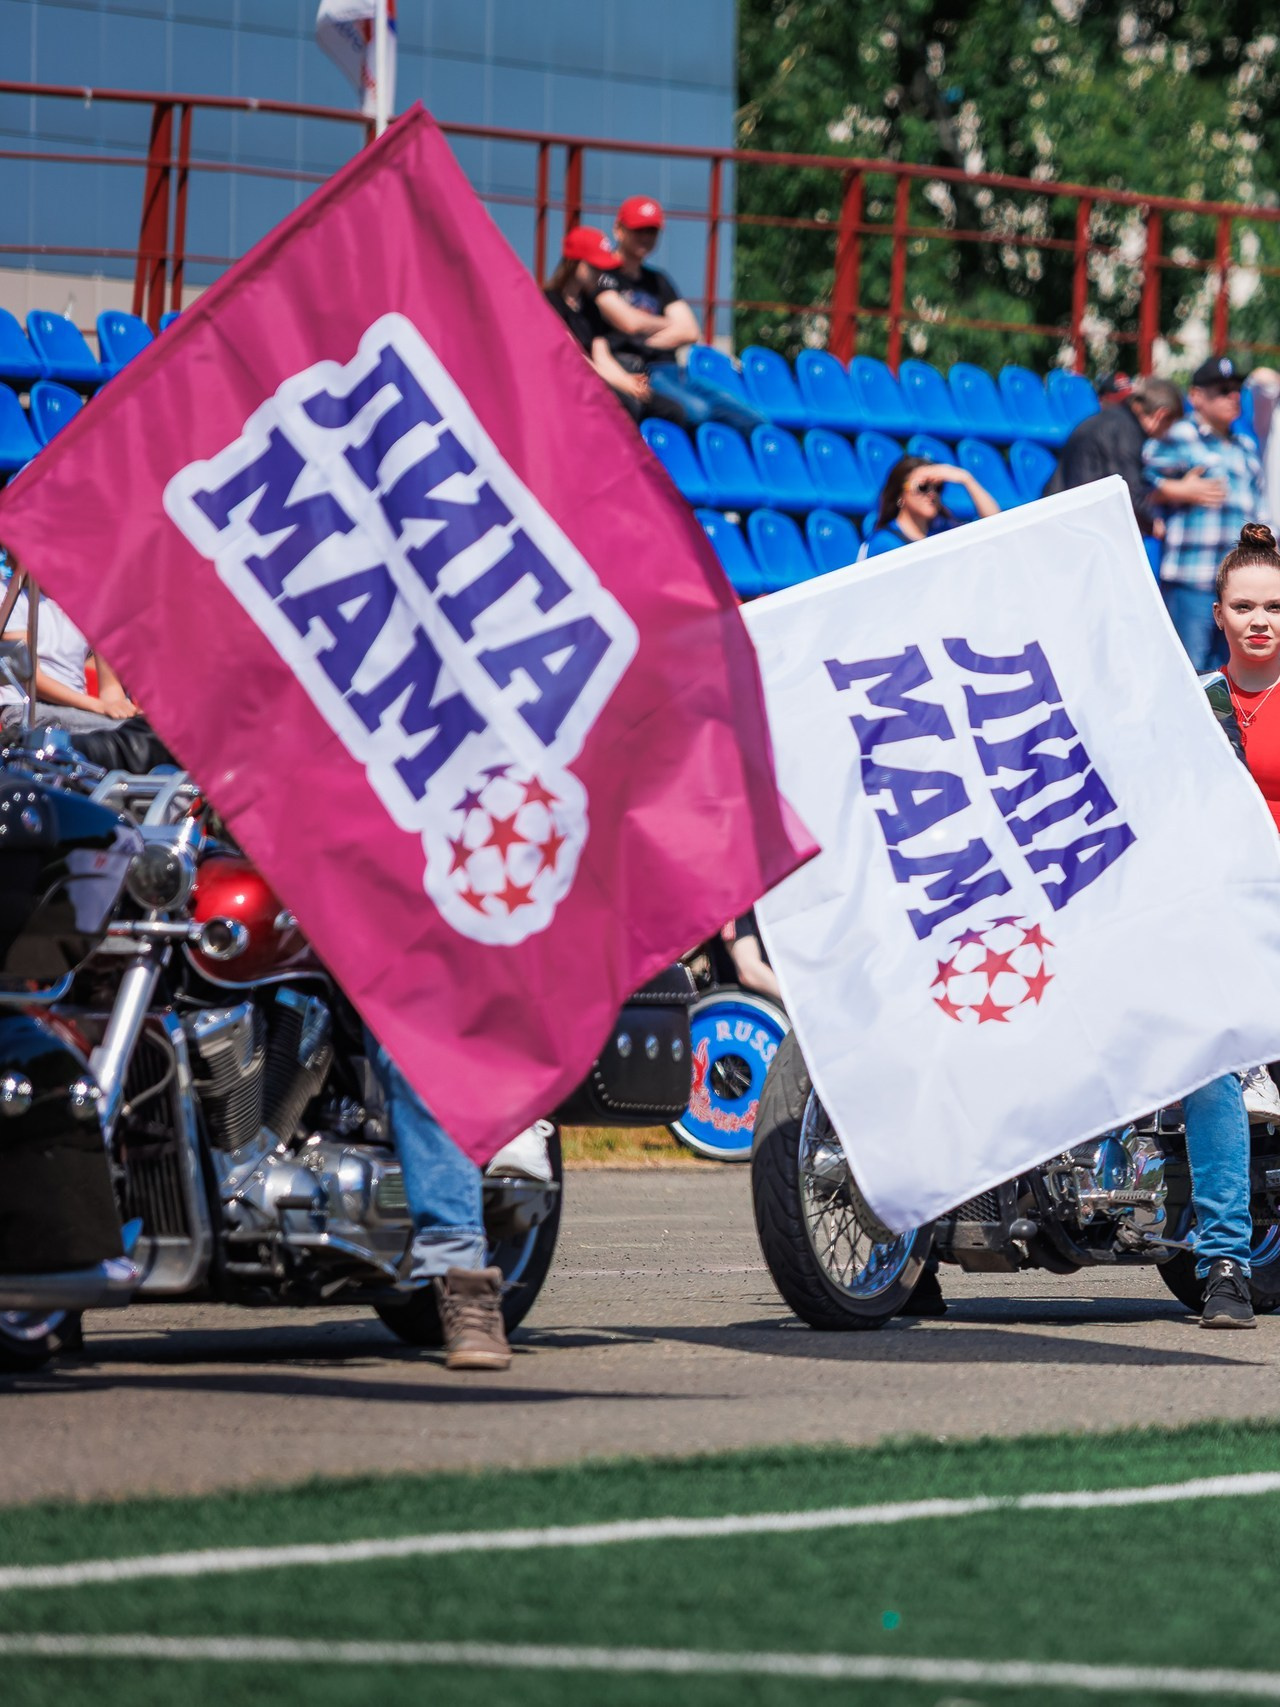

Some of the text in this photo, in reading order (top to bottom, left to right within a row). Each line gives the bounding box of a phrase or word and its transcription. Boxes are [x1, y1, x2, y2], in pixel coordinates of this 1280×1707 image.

[191, 425, 489, 802] МАМ
[302, 343, 612, 748] ЛИГА
[823, 645, 1013, 940] МАМ
[942, 637, 1138, 912] ЛИГА
[716, 1020, 777, 1072] RUSS
